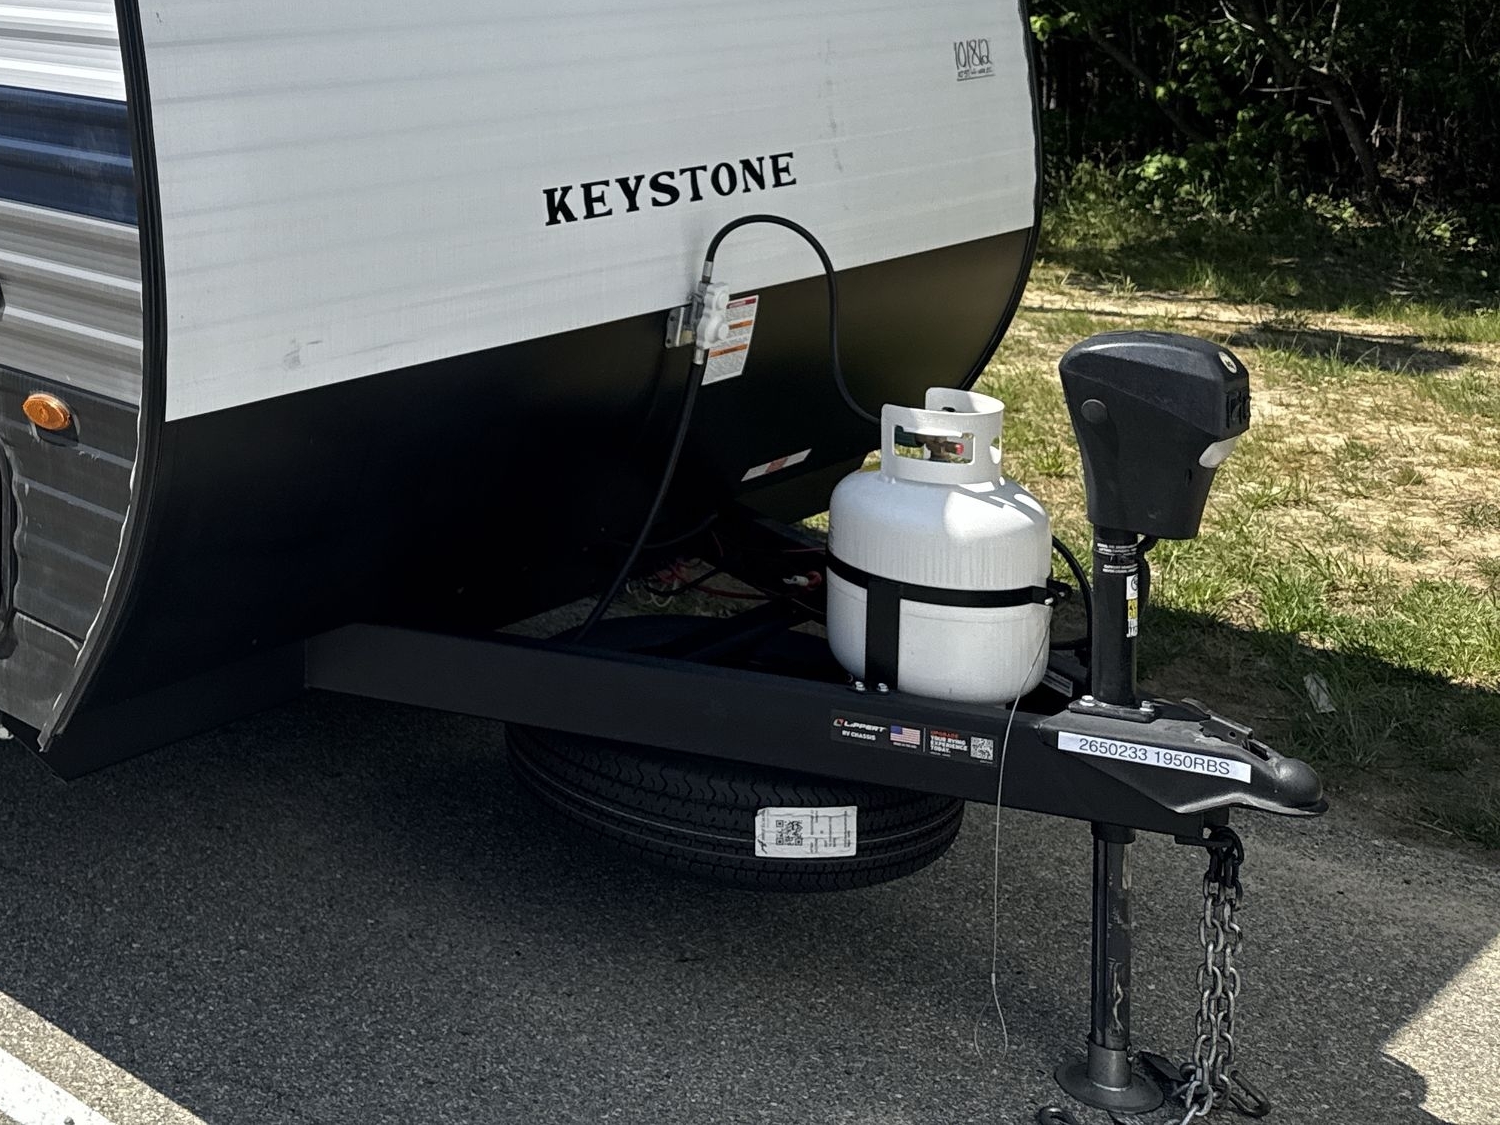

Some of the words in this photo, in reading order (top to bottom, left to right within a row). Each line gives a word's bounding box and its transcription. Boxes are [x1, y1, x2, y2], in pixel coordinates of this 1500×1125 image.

[543, 152, 797, 226] KEYSTONE
[1079, 738, 1148, 761] 2650233
[1154, 751, 1231, 775] 1950RBS
